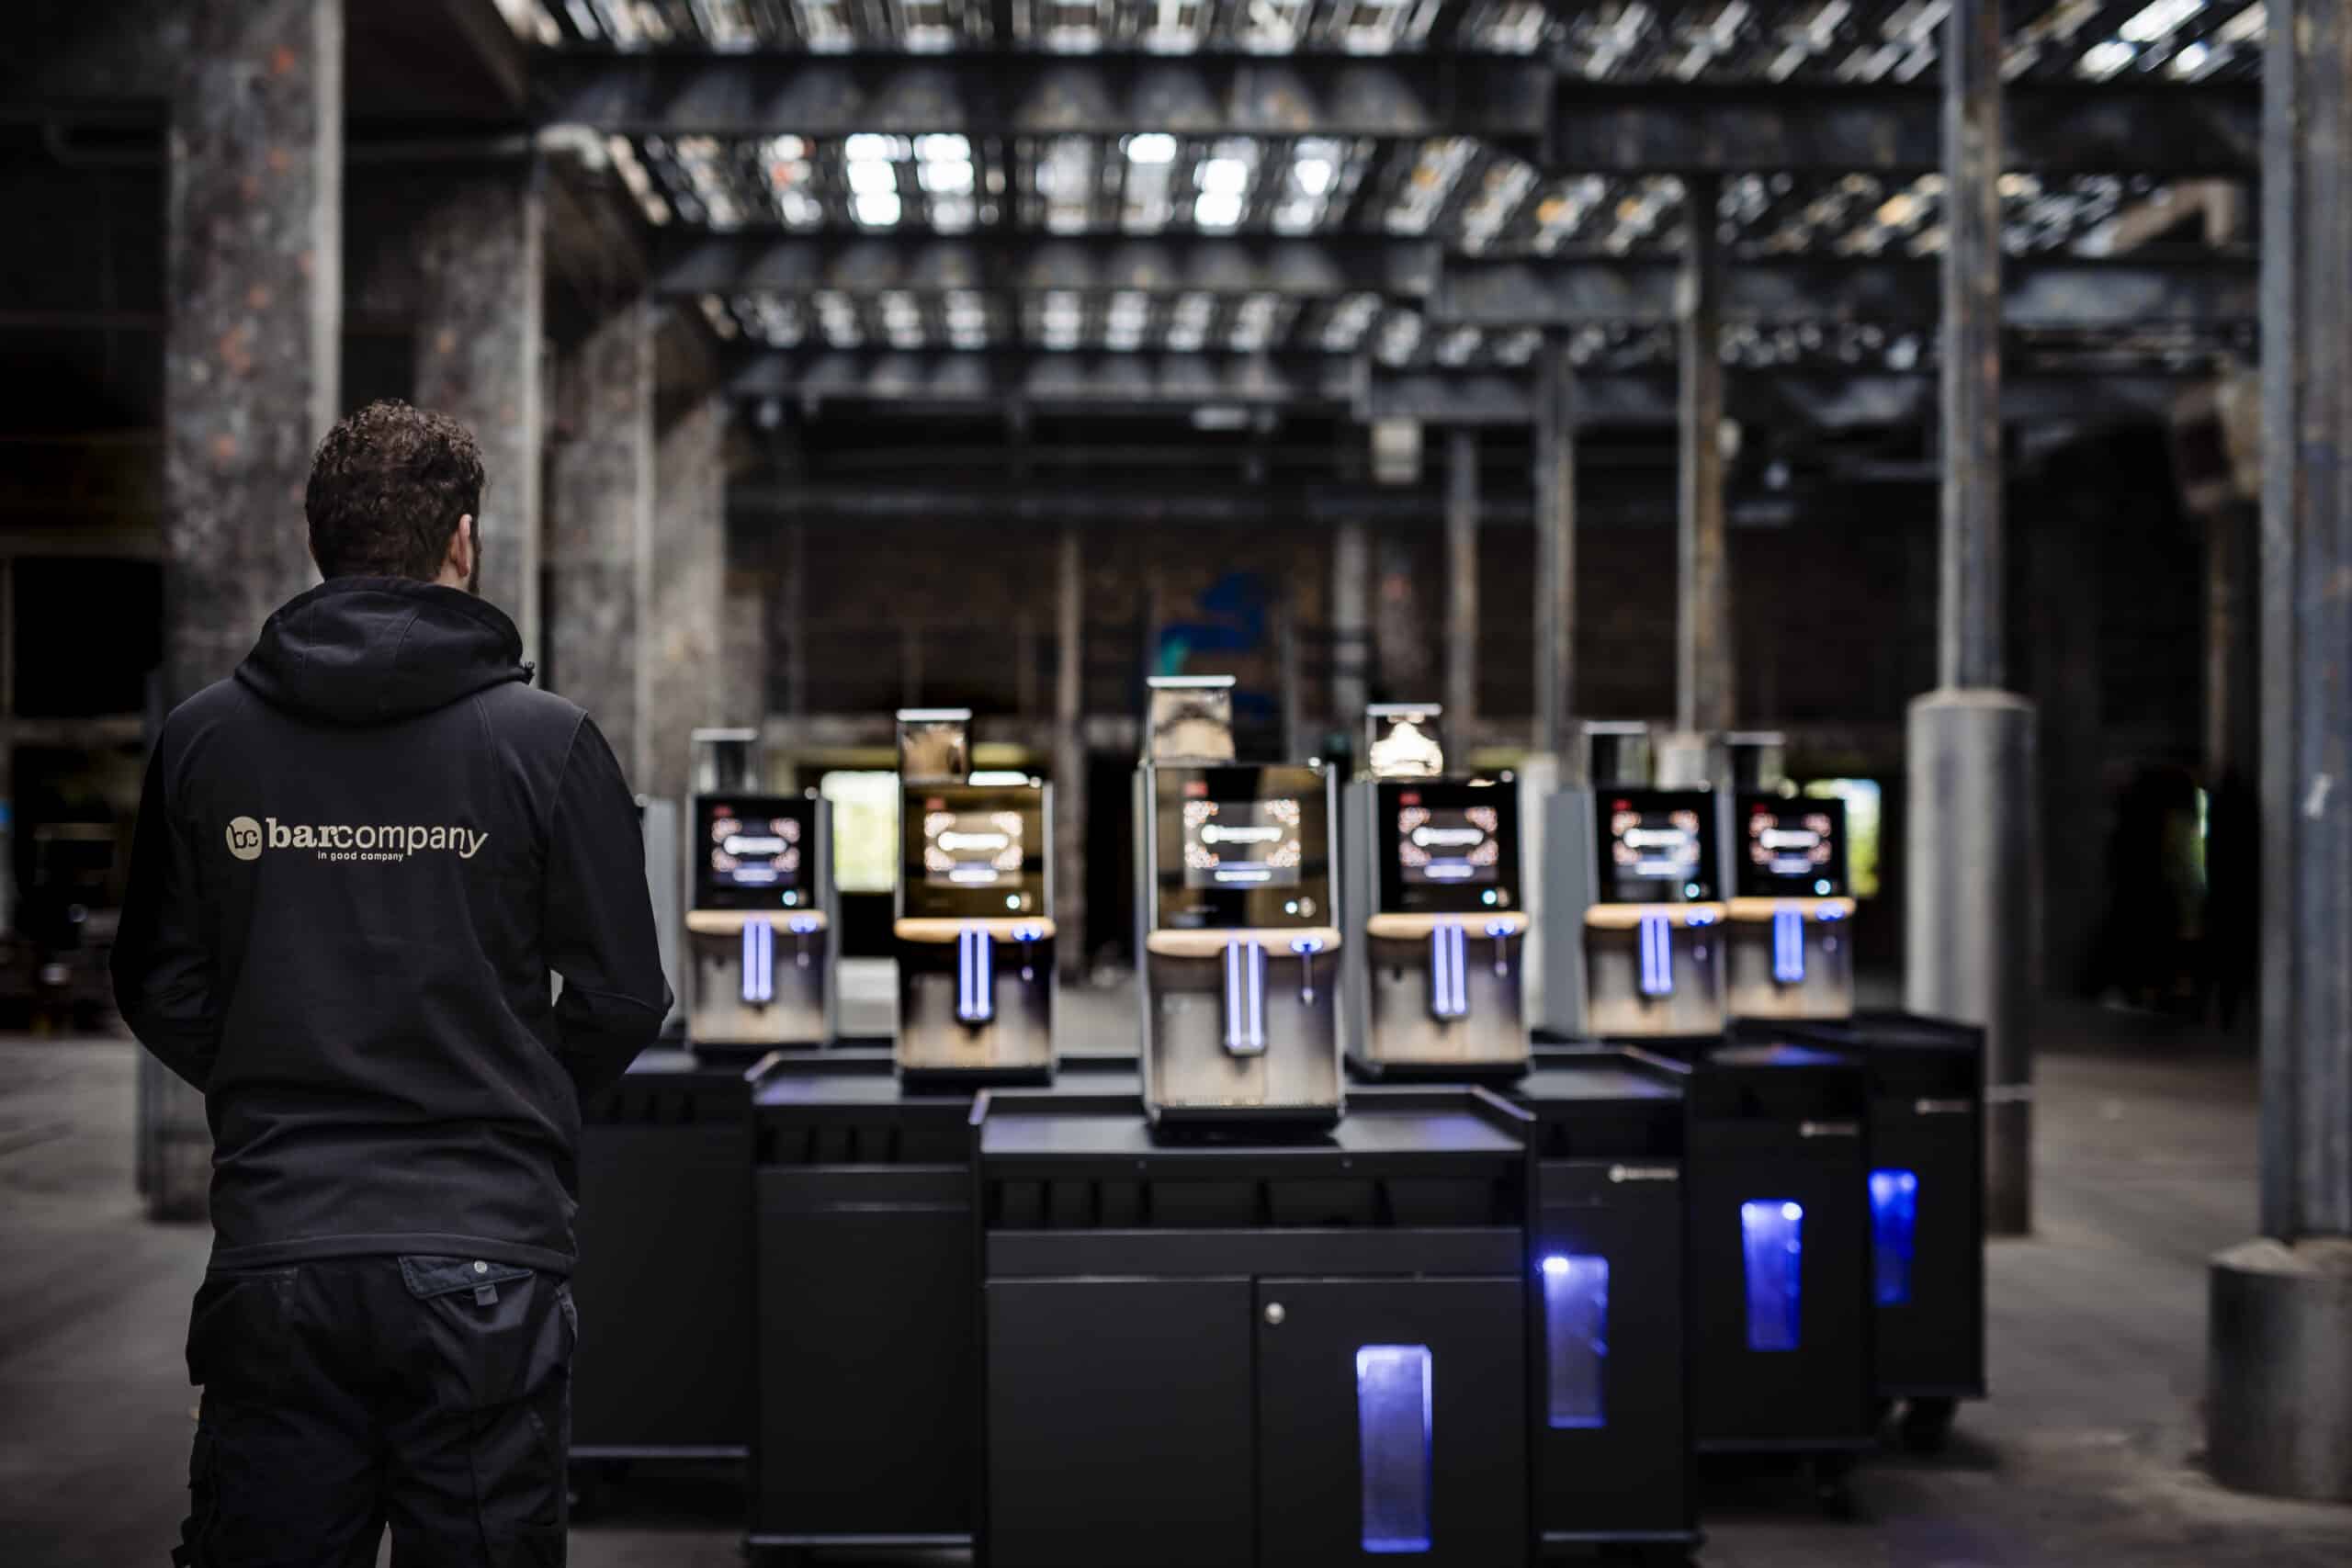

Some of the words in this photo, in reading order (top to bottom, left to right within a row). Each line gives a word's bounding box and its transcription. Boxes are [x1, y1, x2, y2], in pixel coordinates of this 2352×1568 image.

[266, 817, 489, 859] barcompany
[330, 851, 357, 862] good
[360, 852, 404, 863] company
